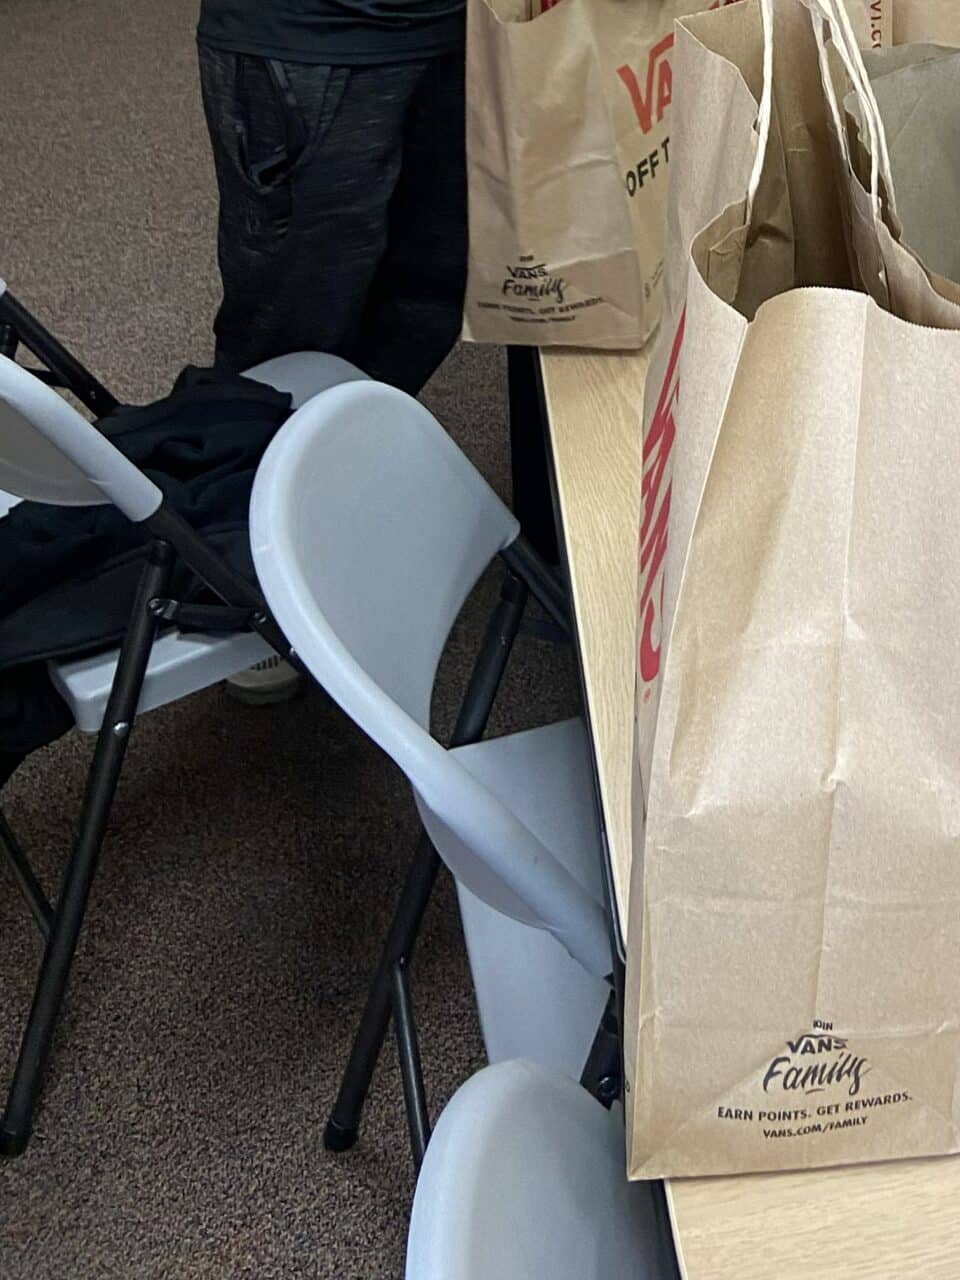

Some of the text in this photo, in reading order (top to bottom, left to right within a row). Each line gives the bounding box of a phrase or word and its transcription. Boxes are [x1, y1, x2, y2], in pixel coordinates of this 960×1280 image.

[625, 149, 660, 198] OFF
[507, 263, 548, 280] VANS
[502, 278, 564, 303] Family
[786, 1034, 849, 1054] VANS
[762, 1052, 872, 1095] Family
[717, 1092, 913, 1121] EARN POINTS. GET REWARDS.
[762, 1116, 868, 1139] VANS.COM/FAMILY
